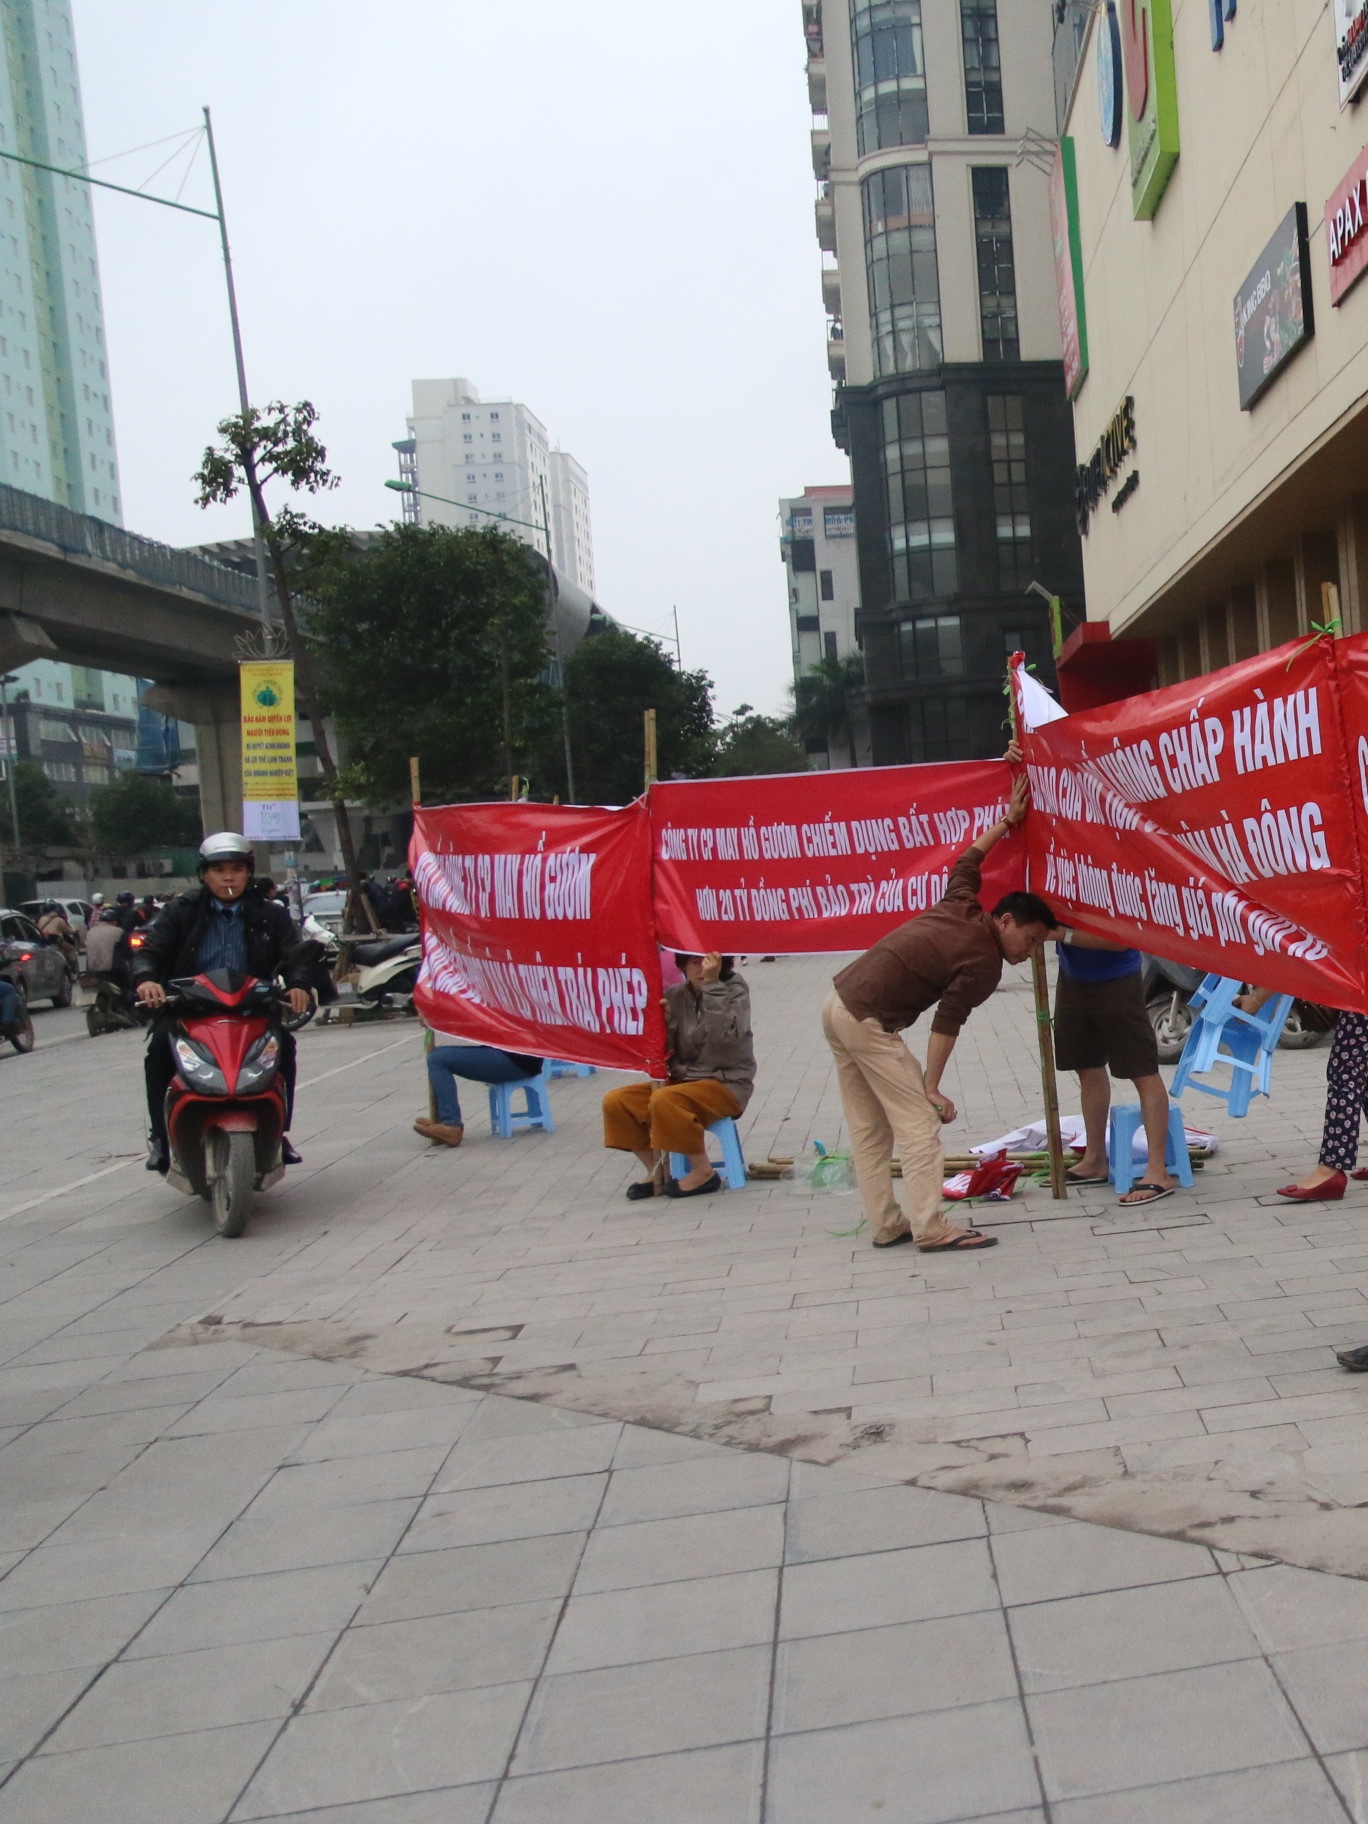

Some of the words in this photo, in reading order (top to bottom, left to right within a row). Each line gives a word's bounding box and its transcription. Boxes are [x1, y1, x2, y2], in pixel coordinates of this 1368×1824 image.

[1330, 179, 1363, 266] APAX
[1158, 697, 1225, 794] CHẤP
[1232, 687, 1323, 775] HÀNH
[477, 854, 491, 918] CP
[494, 854, 521, 919] MAY
[523, 831, 546, 920] HỒ
[544, 846, 597, 920] GƯƠM
[660, 821, 687, 861] CÔNG
[687, 828, 699, 861] TY
[700, 828, 713, 861] CP
[715, 827, 740, 861] MAY
[740, 815, 759, 860] HỒ
[760, 822, 801, 860] GƯƠM
[801, 811, 851, 858] CHIẾM
[851, 817, 900, 861] DỤNG
[898, 803, 934, 849] BẤT
[933, 806, 970, 851] HỢP
[1210, 809, 1260, 885] HÀ
[1243, 798, 1331, 879] ĐÔNG
[696, 885, 719, 921] HƠN
[719, 889, 735, 921] 20
[734, 877, 750, 921] TỶ
[750, 877, 790, 921] ĐỒNG
[788, 879, 818, 920] PHÍ
[815, 874, 850, 919] BẢO
[849, 874, 876, 916] TRÌ
[875, 867, 904, 914] CỦA
[907, 871, 929, 911] CƯ
[557, 952, 600, 1034] TRÁI
[597, 952, 648, 1036] PHÉP
